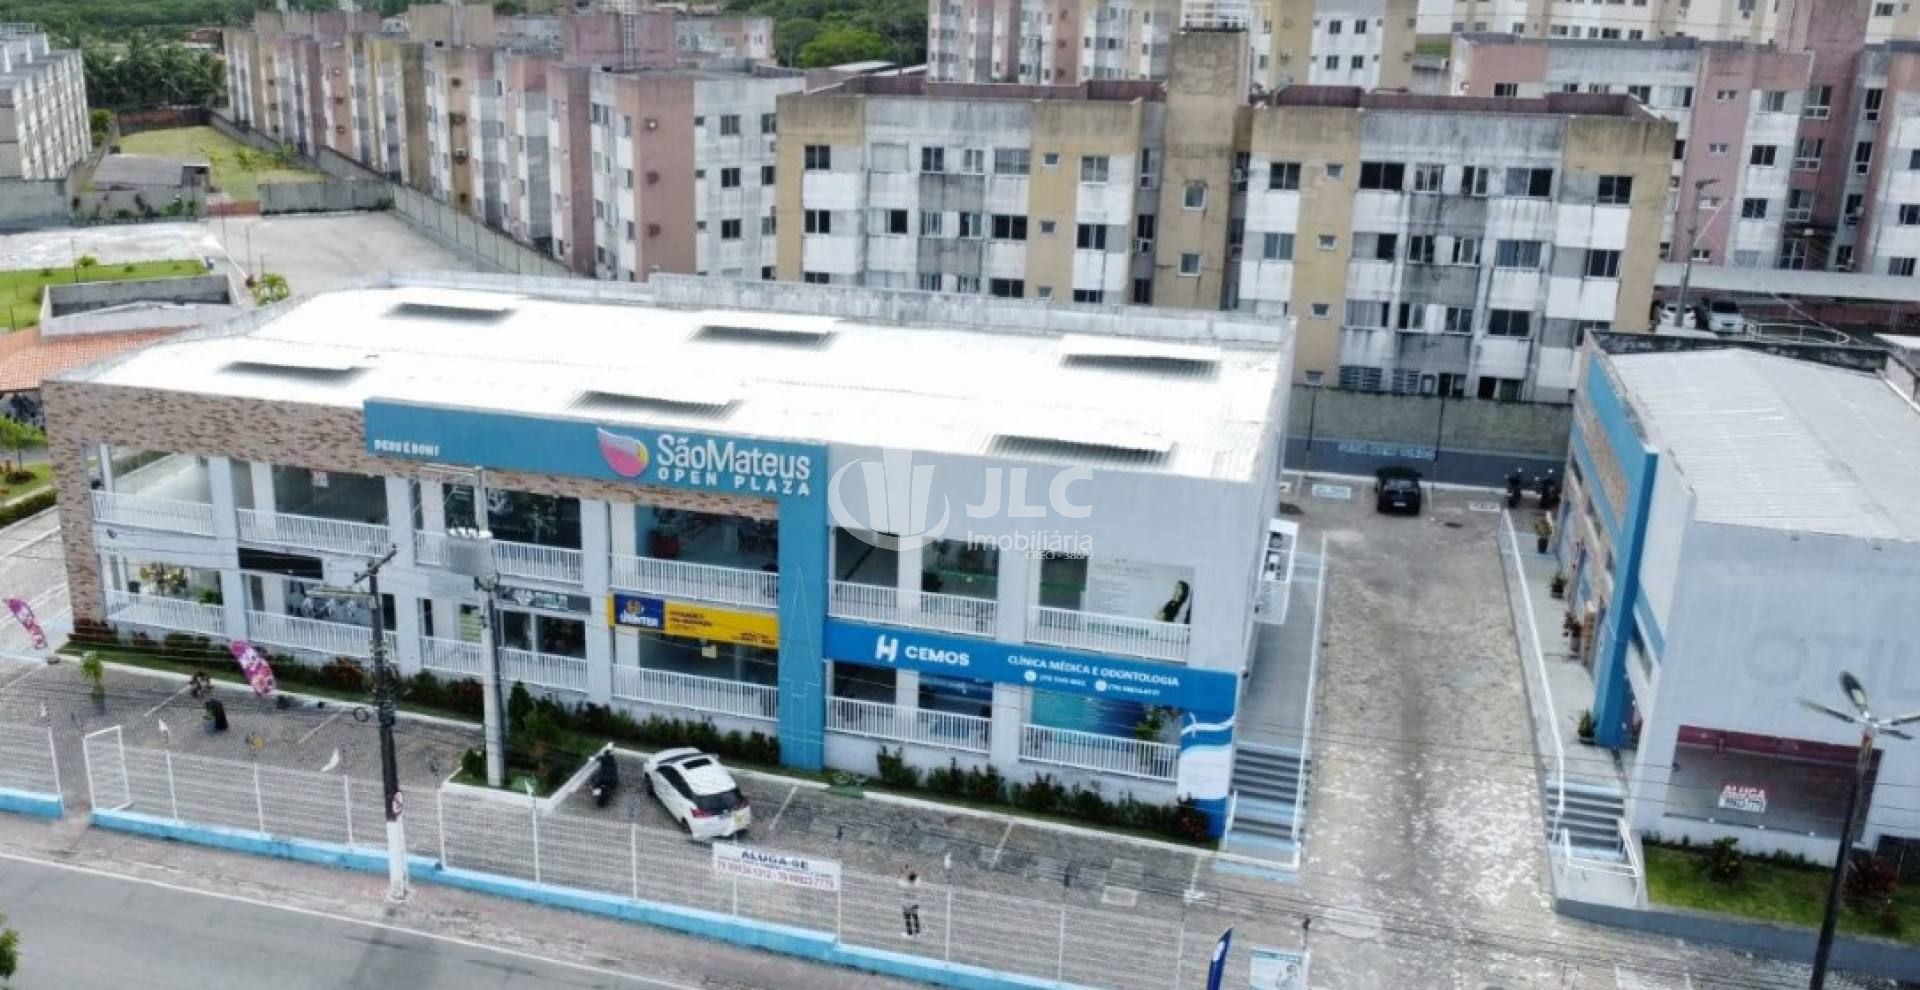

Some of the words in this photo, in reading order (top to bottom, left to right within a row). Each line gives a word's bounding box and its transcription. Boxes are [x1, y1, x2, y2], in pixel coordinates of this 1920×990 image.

[657, 434, 811, 480] SãoMateus
[658, 466, 717, 486] OPEN
[734, 475, 810, 496] PLAZA
[904, 645, 970, 667] CEMOS
[1007, 655, 1047, 669] CLÍNICA
[1048, 659, 1090, 675] MÉDICA
[1092, 666, 1099, 676] E
[1100, 667, 1180, 687] ODONTOLOGIA
[742, 850, 809, 869] ALUGA-SE
